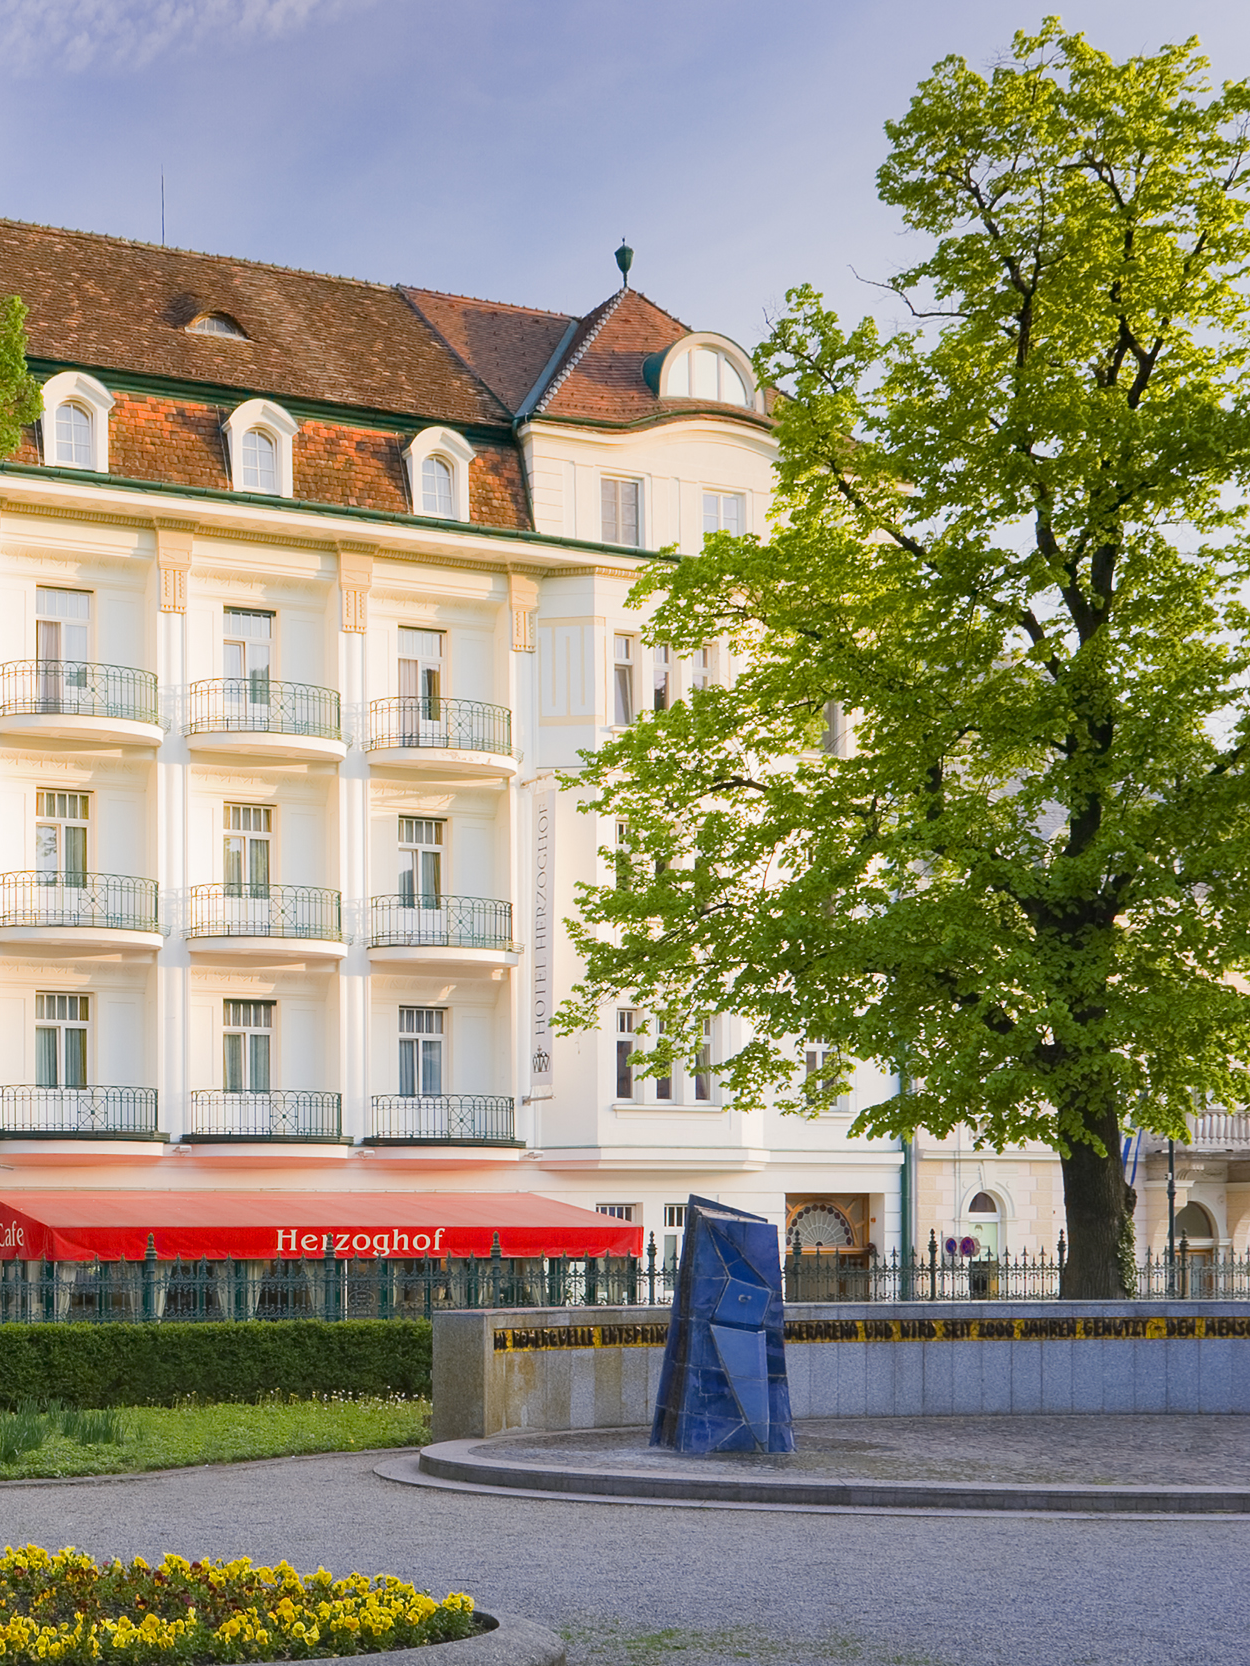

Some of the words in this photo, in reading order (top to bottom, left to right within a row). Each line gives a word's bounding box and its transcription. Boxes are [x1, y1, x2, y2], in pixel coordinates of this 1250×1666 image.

[535, 803, 549, 950] HERZOGHOF
[535, 957, 547, 1035] HOTEL
[601, 1324, 669, 1346] ENTSPRIN
